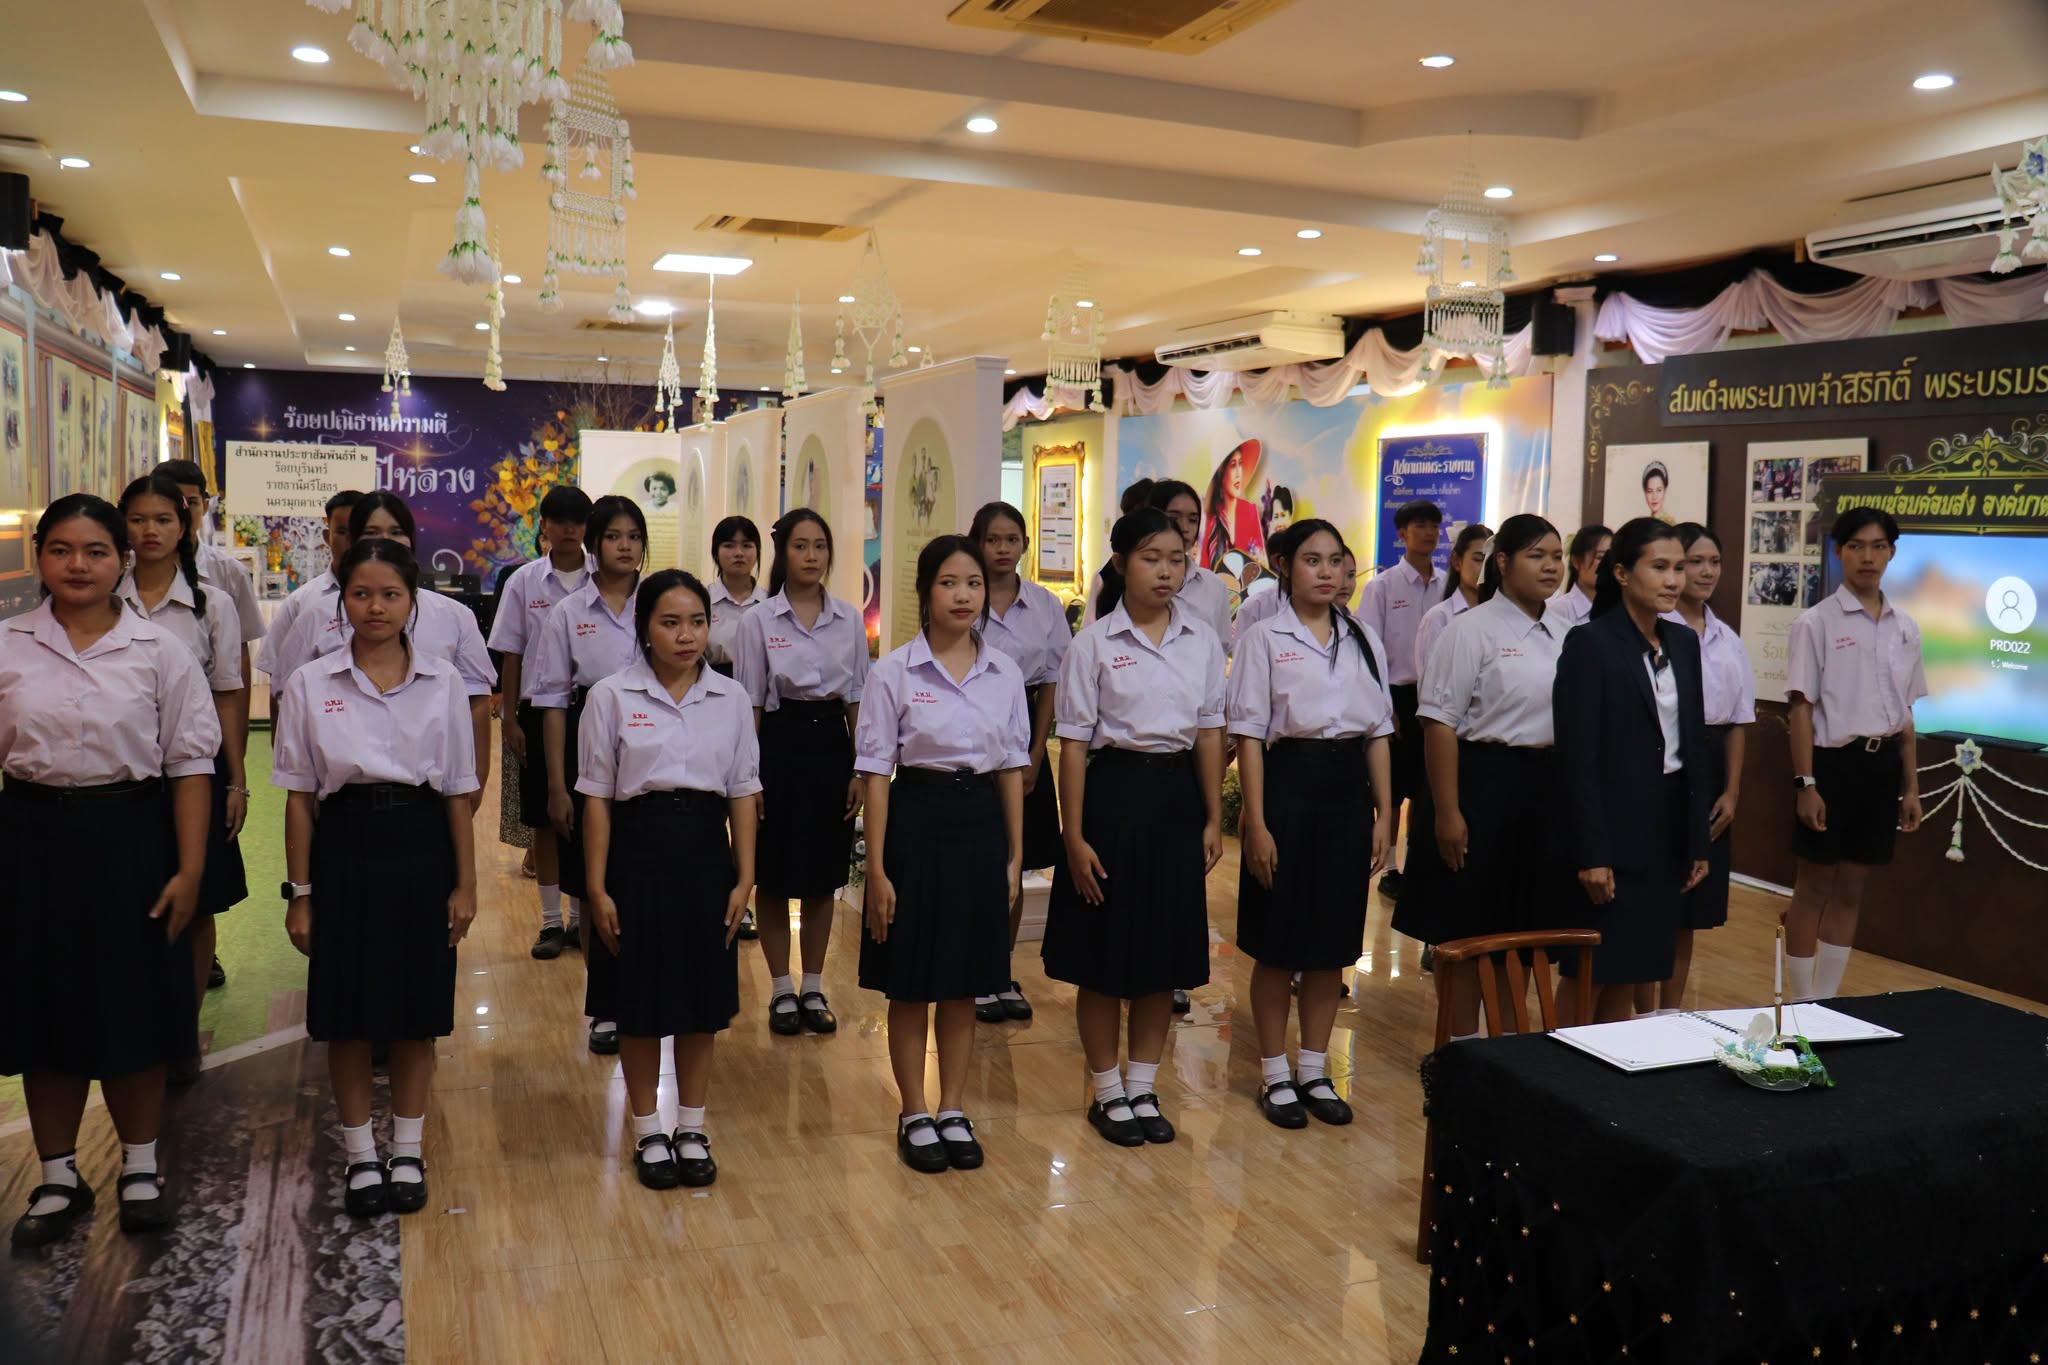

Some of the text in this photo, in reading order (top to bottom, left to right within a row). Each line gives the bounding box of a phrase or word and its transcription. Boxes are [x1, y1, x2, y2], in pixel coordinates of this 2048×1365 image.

[1669, 356, 1918, 413] สมเด็จพระนางเจ้าสิริกิติ์
[283, 406, 448, 434] ร้อยปณิธานความดี
[1990, 639, 2030, 654] PRD022
